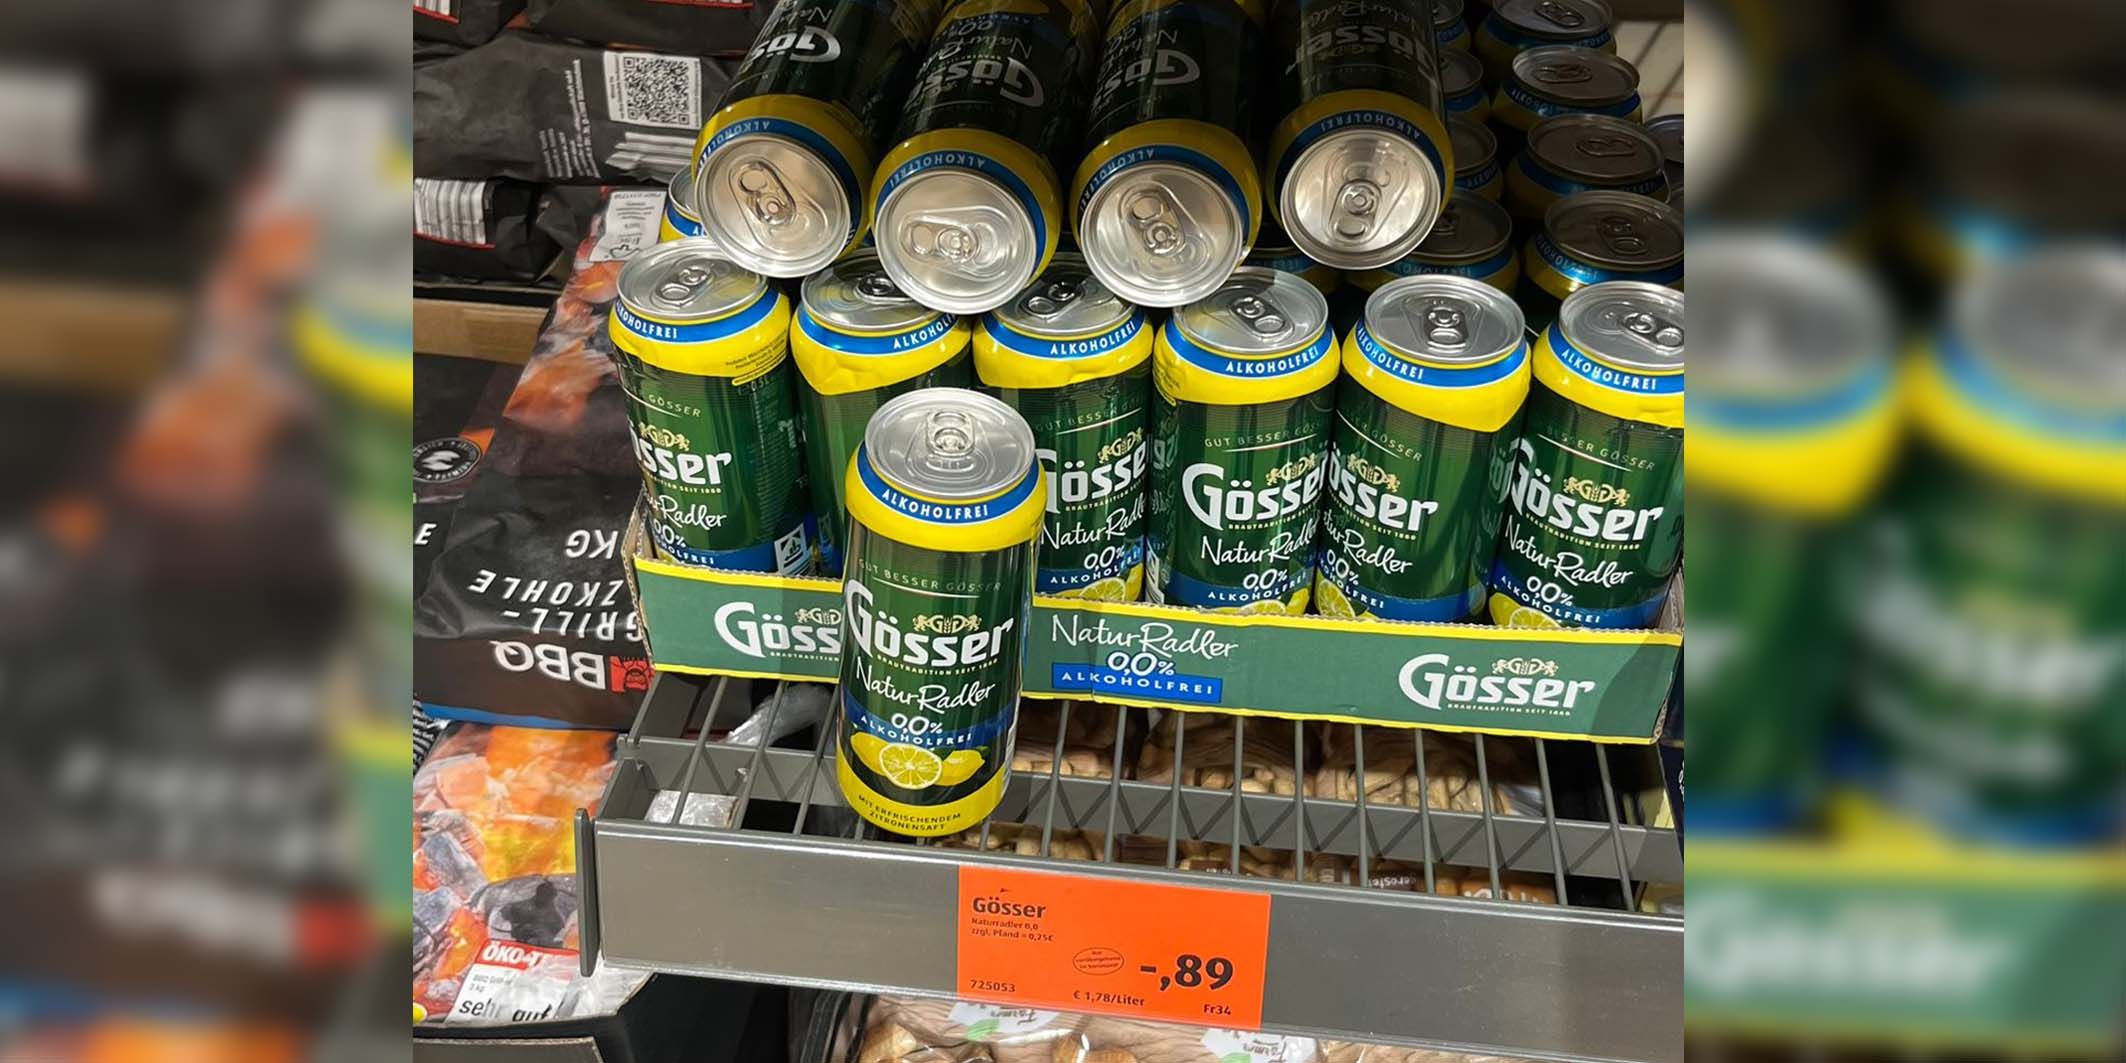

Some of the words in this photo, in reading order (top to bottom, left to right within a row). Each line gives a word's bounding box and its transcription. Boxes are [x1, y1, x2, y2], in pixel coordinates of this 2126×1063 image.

[1320, 112, 1421, 140] ALKOHOLFREI
[889, 153, 985, 188] ALKOHOLFREI
[1050, 321, 1136, 355] ALKOHOLFREI
[1356, 327, 1425, 380] ALKOHOLFREI
[1225, 346, 1320, 375] ALKOHOLFREI
[1561, 348, 1657, 391] ALKOHOLFREI
[1204, 436, 1232, 448] GUT
[565, 528, 619, 560] KG
[1083, 543, 1126, 572] 0,0%
[1504, 513, 1635, 589] NaturRadler
[467, 567, 625, 607] ZKOHLE
[883, 569, 939, 590] BESSER
[1207, 571, 1308, 601] ALKOHOLFREI
[1243, 568, 1288, 593] 0,0%
[1526, 575, 1575, 608] 0,0%
[1500, 574, 1602, 624] ALKOHOLFREI
[502, 605, 644, 642] GRILL-
[713, 600, 843, 659] Göss
[845, 578, 1016, 668] Gösser
[1051, 613, 1240, 661] NaturRadler
[490, 641, 607, 690] BBQ
[1106, 650, 1176, 678] 0,0%
[856, 655, 997, 714] NaturRadler
[1060, 671, 1214, 696] ALKOHOLFREI
[1398, 652, 1597, 711] Gösser
[859, 714, 973, 747] ALKOHOLFREI
[890, 712, 944, 736] 0,0%
[857, 793, 875, 810] MIT
[874, 802, 962, 825] ERFRISCHENDEM
[868, 810, 946, 832] ZITRONENSAFT
[971, 916, 1024, 930] Naturradler
[972, 896, 1047, 919] Gösser
[993, 929, 1020, 939] Pfand
[482, 941, 545, 967] ÖKO-T
[970, 978, 1016, 994] 725053
[1140, 953, 1235, 992] -,89
[1073, 989, 1081, 1001] €
[1084, 990, 1146, 1008] 1,78/Liter
[1203, 1003, 1232, 1017] Fr34
